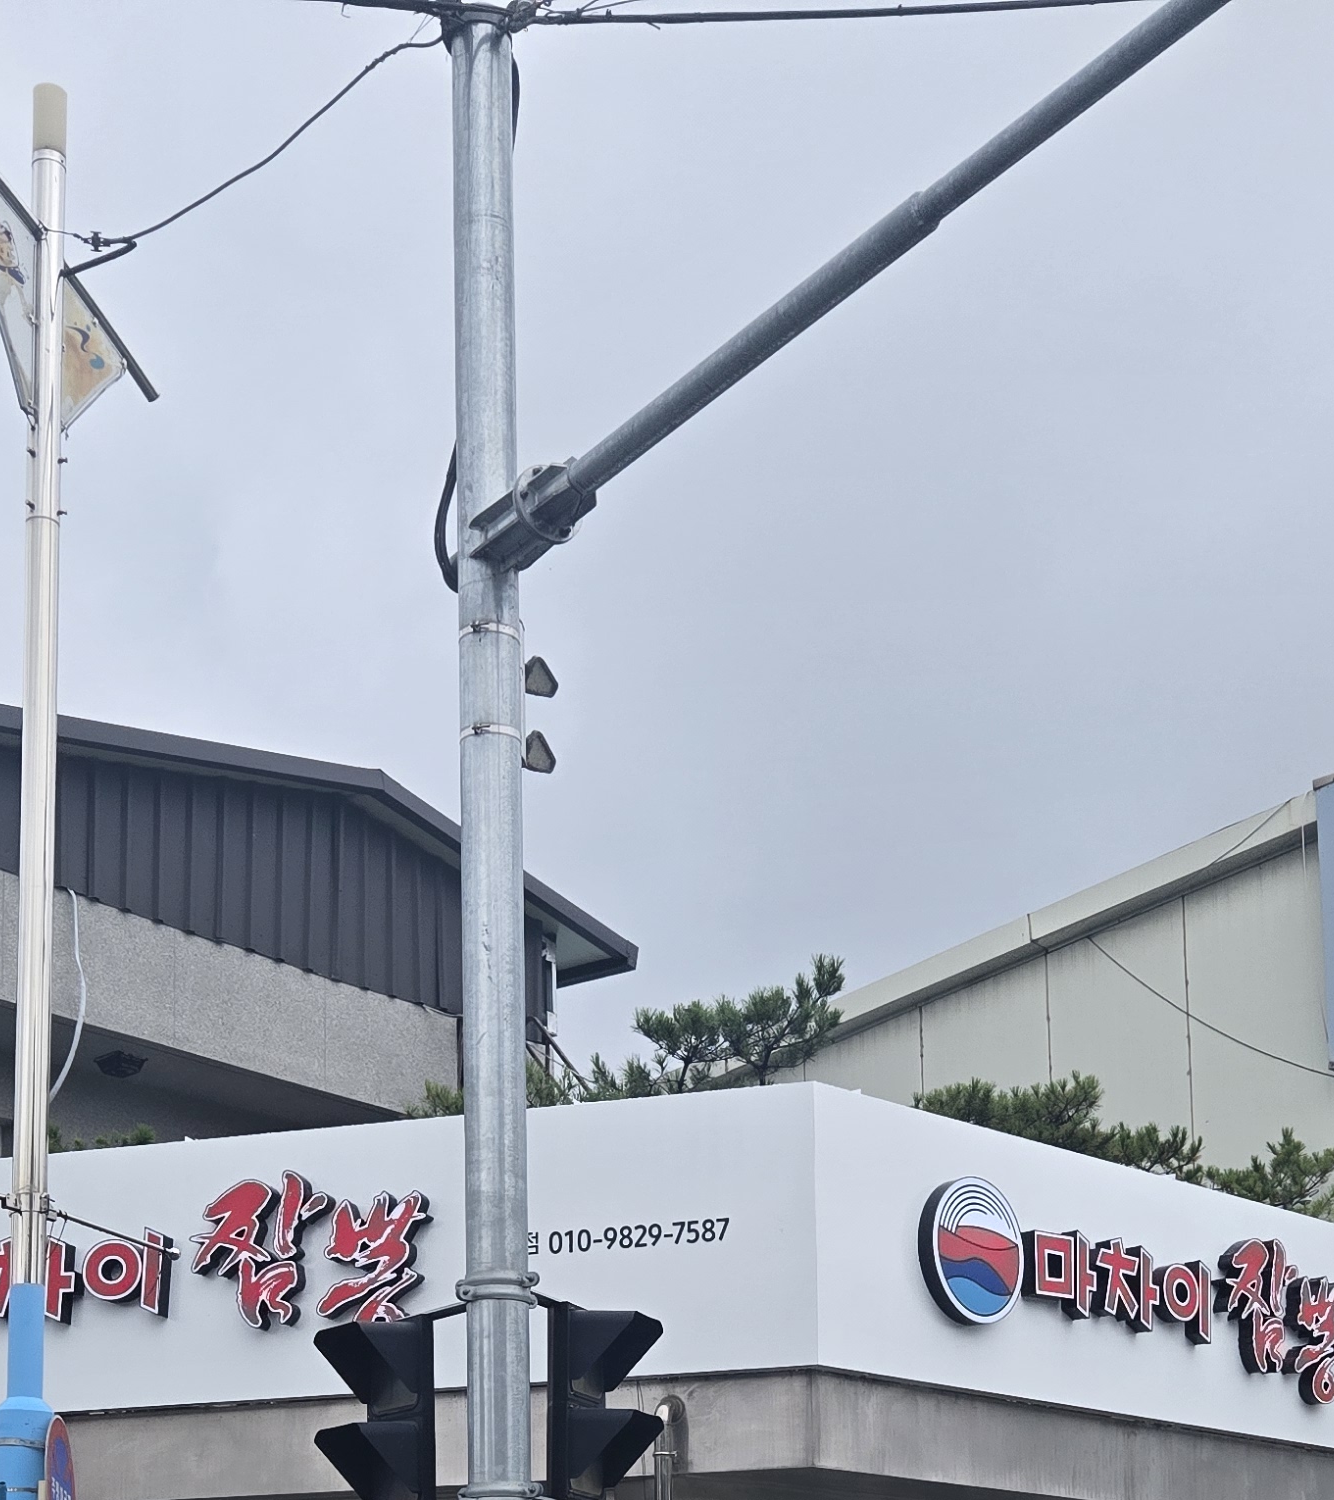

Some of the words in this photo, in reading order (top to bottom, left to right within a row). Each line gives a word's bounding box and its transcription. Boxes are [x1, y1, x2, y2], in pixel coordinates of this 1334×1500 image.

[190, 1168, 435, 1330] 짬뽕
[548, 1217, 730, 1255] 010-9829-7587
[1025, 1228, 1212, 1345] 마차이
